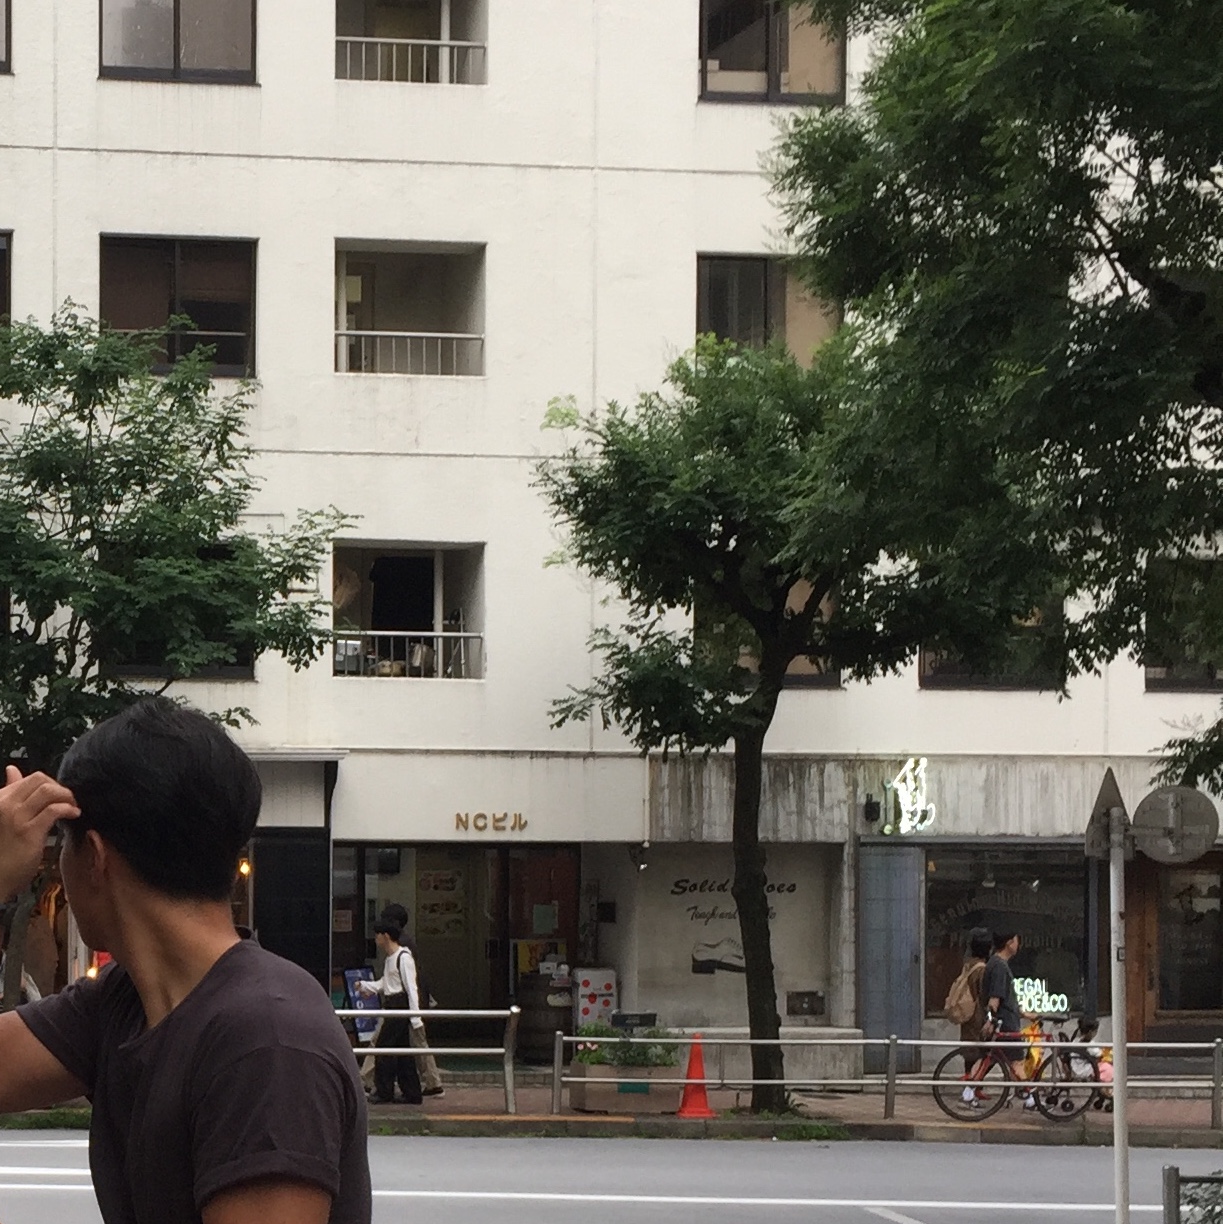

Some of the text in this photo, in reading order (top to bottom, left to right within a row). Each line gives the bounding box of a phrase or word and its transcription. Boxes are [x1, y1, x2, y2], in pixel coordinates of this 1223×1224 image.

[455, 812, 528, 832] NCビル
[670, 879, 797, 895] Solid oes
